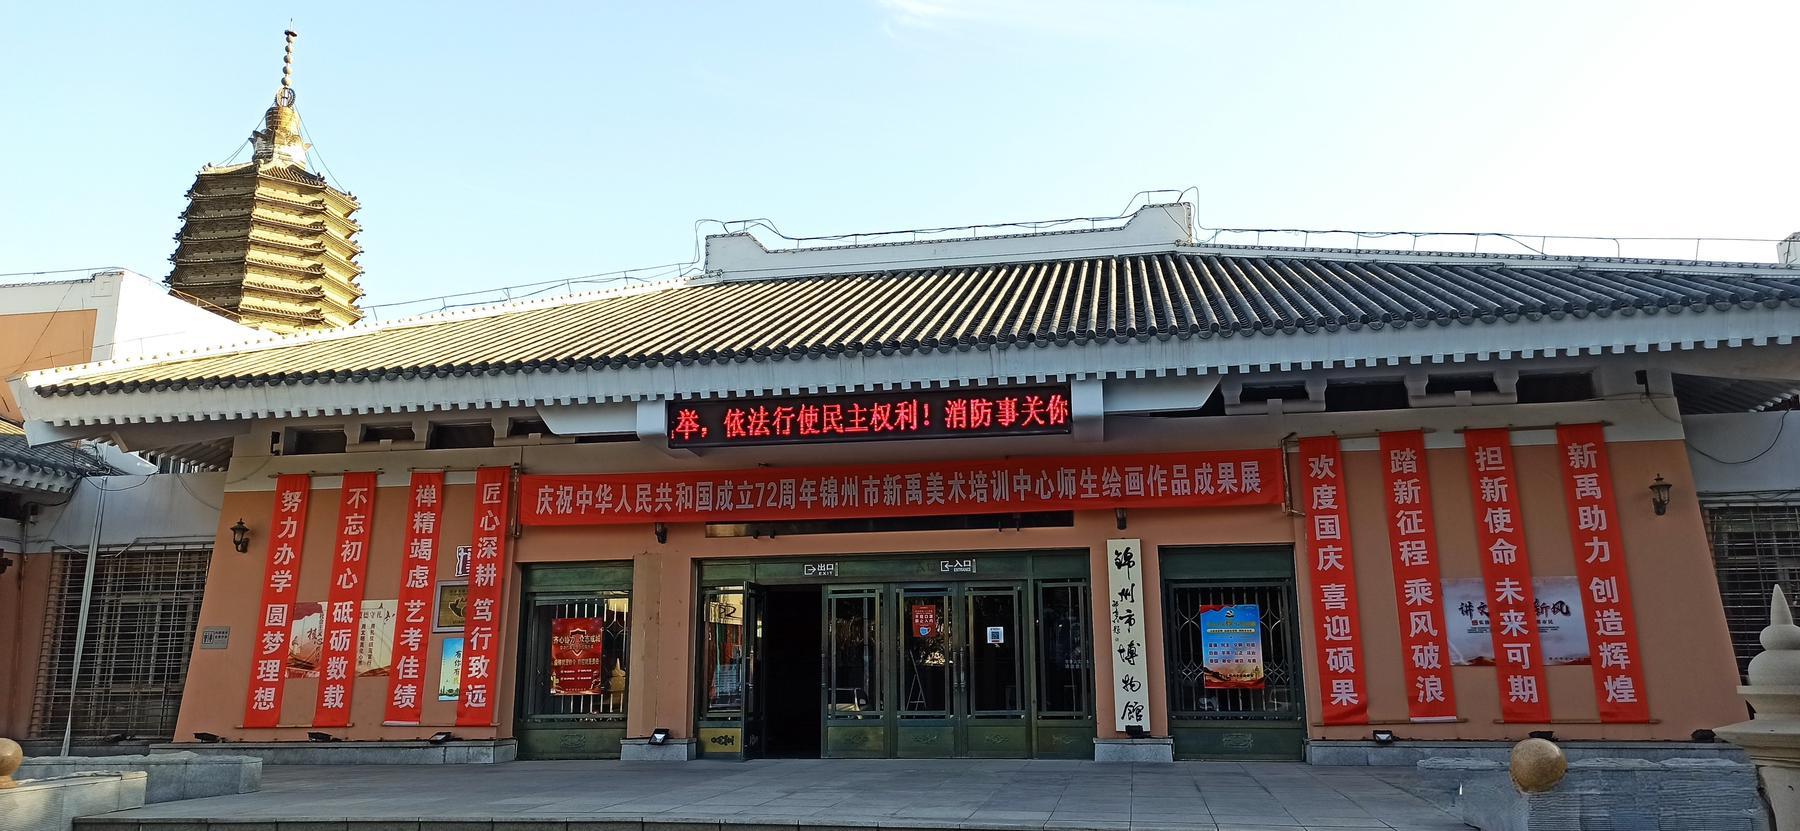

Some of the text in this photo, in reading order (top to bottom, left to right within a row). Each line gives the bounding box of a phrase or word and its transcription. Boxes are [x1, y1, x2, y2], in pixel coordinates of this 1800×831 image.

[252, 489, 303, 711] 努力办学 圆梦理想
[322, 487, 368, 709] 不忘初心 砥砺数载
[393, 484, 437, 709] 禅精竭虑 艺考佳绩
[464, 482, 502, 708] 匠心深耕 笃行致远
[535, 460, 1262, 516] 庆祝中华人民共和国成立72周年锦州市新禹美术培训中心师生绘画作品成果展
[817, 563, 834, 571] 出口
[953, 559, 972, 568] 入口
[1308, 454, 1358, 706] 欢度国庆 喜迎硕果
[1390, 448, 1445, 704] 踏新征程 乘风破浪
[1475, 446, 1539, 704] 担新使命 未来可期
[1568, 442, 1638, 704] 新禹助力 创造辉煌
